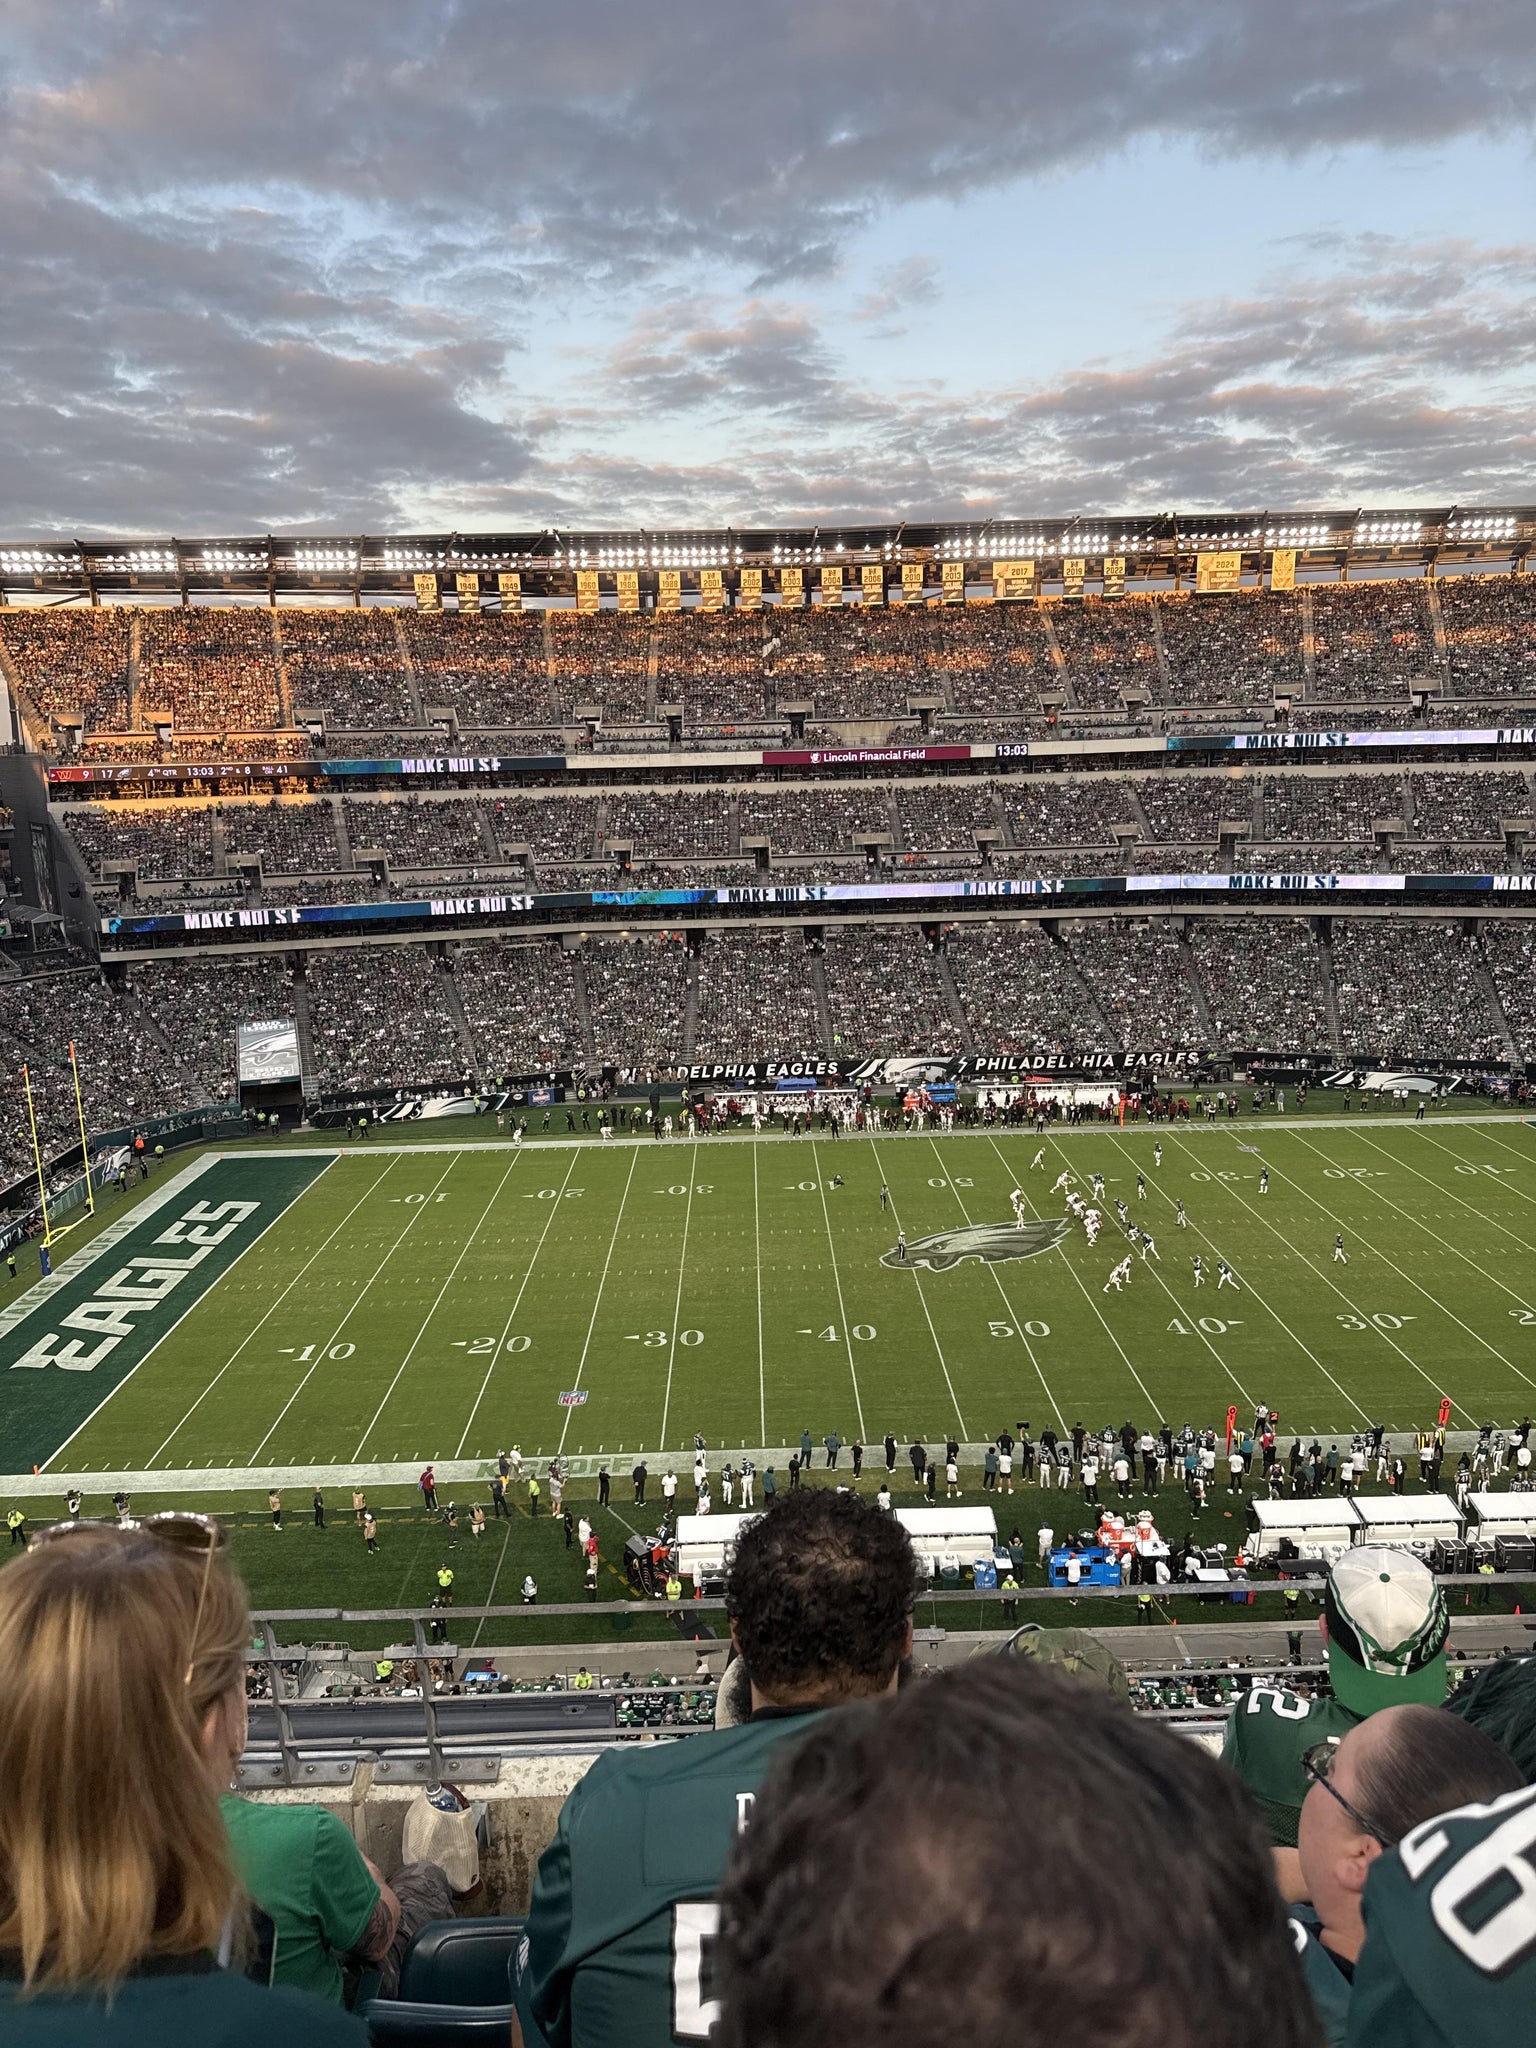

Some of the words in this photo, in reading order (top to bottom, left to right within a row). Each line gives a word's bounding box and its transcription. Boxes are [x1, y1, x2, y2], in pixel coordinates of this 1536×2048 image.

[743, 579, 760, 587] 2002
[945, 572, 961, 580] 2013
[580, 581, 596, 589] 1960
[1246, 735, 1289, 748] MAKE
[1497, 728, 1536, 743] MAK
[823, 751, 857, 762] Lincoln
[859, 750, 901, 761] Financial
[903, 749, 925, 760] Field
[997, 745, 1028, 757] 13:03
[163, 769, 178, 777] QTR
[187, 767, 214, 776] 13:03
[244, 766, 251, 775] 8
[277, 765, 288, 774] 41
[401, 759, 444, 773] MAKE
[83, 770, 90, 779] 9
[102, 769, 113, 779] 17
[964, 881, 1006, 896] MAKE
[1228, 875, 1274, 889] MAKE
[1493, 876, 1536, 890] MAK
[728, 888, 770, 902] MAKE
[430, 898, 475, 916] MAKE
[183, 910, 234, 930] MAKE
[1123, 1051, 1201, 1067] EAGLES
[766, 1061, 839, 1076] EAGLES
[55, 1254, 97, 1276] ALL
[86, 1236, 116, 1251] OF
[109, 1219, 138, 1233] US
[9, 1199, 262, 1372] EAGLES
[987, 1319, 1052, 1338] 50
[1166, 1316, 1229, 1336] 40
[1335, 1312, 1403, 1331] 30
[643, 1329, 705, 1348] 30
[817, 1324, 878, 1343] 40
[291, 1342, 357, 1362] 10
[466, 1335, 533, 1355] 20
